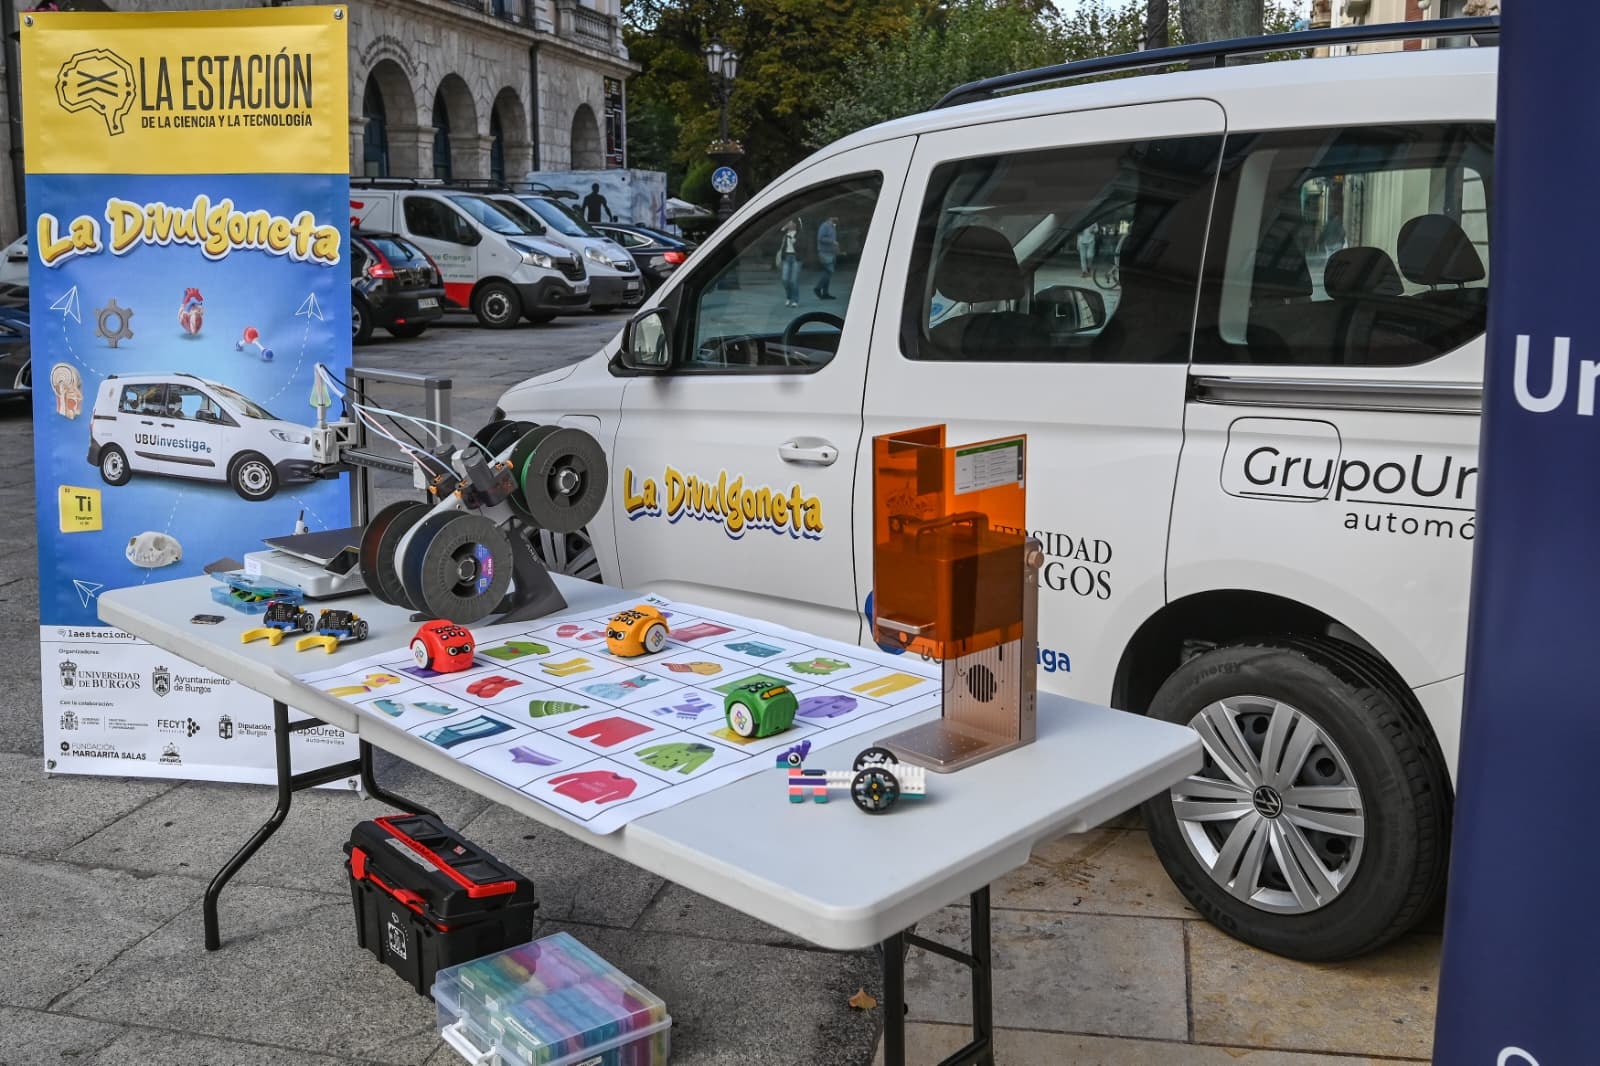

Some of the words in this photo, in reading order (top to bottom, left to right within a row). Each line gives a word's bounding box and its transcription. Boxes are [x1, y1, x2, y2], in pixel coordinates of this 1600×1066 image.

[140, 56, 174, 110] LA
[181, 46, 313, 110] ESTACIÓN
[141, 116, 155, 129] DE
[157, 116, 171, 128] LA
[174, 115, 216, 128] CIENCIA
[218, 115, 225, 127] Y
[227, 114, 241, 127] LA
[243, 111, 313, 127] TECNOLOGÍA
[39, 214, 99, 264] La
[107, 197, 340, 264] Divulgoneta
[135, 433, 206, 452] UBUinvestiga
[1243, 446, 1478, 501] GrupoUr
[75, 495, 92, 512] Ti
[623, 466, 659, 517] La
[664, 465, 825, 536] Divulgoneta
[1343, 512, 1476, 540] automó
[78, 670, 140, 681] UNIVERSIDAD
[174, 675, 231, 686] Ayuntamiento
[92, 680, 141, 689] BURGOS
[185, 684, 212, 695] Burgos
[157, 719, 186, 729] FECYT
[72, 750, 120, 759] MARGARITA
[121, 752, 146, 761] SALAS
